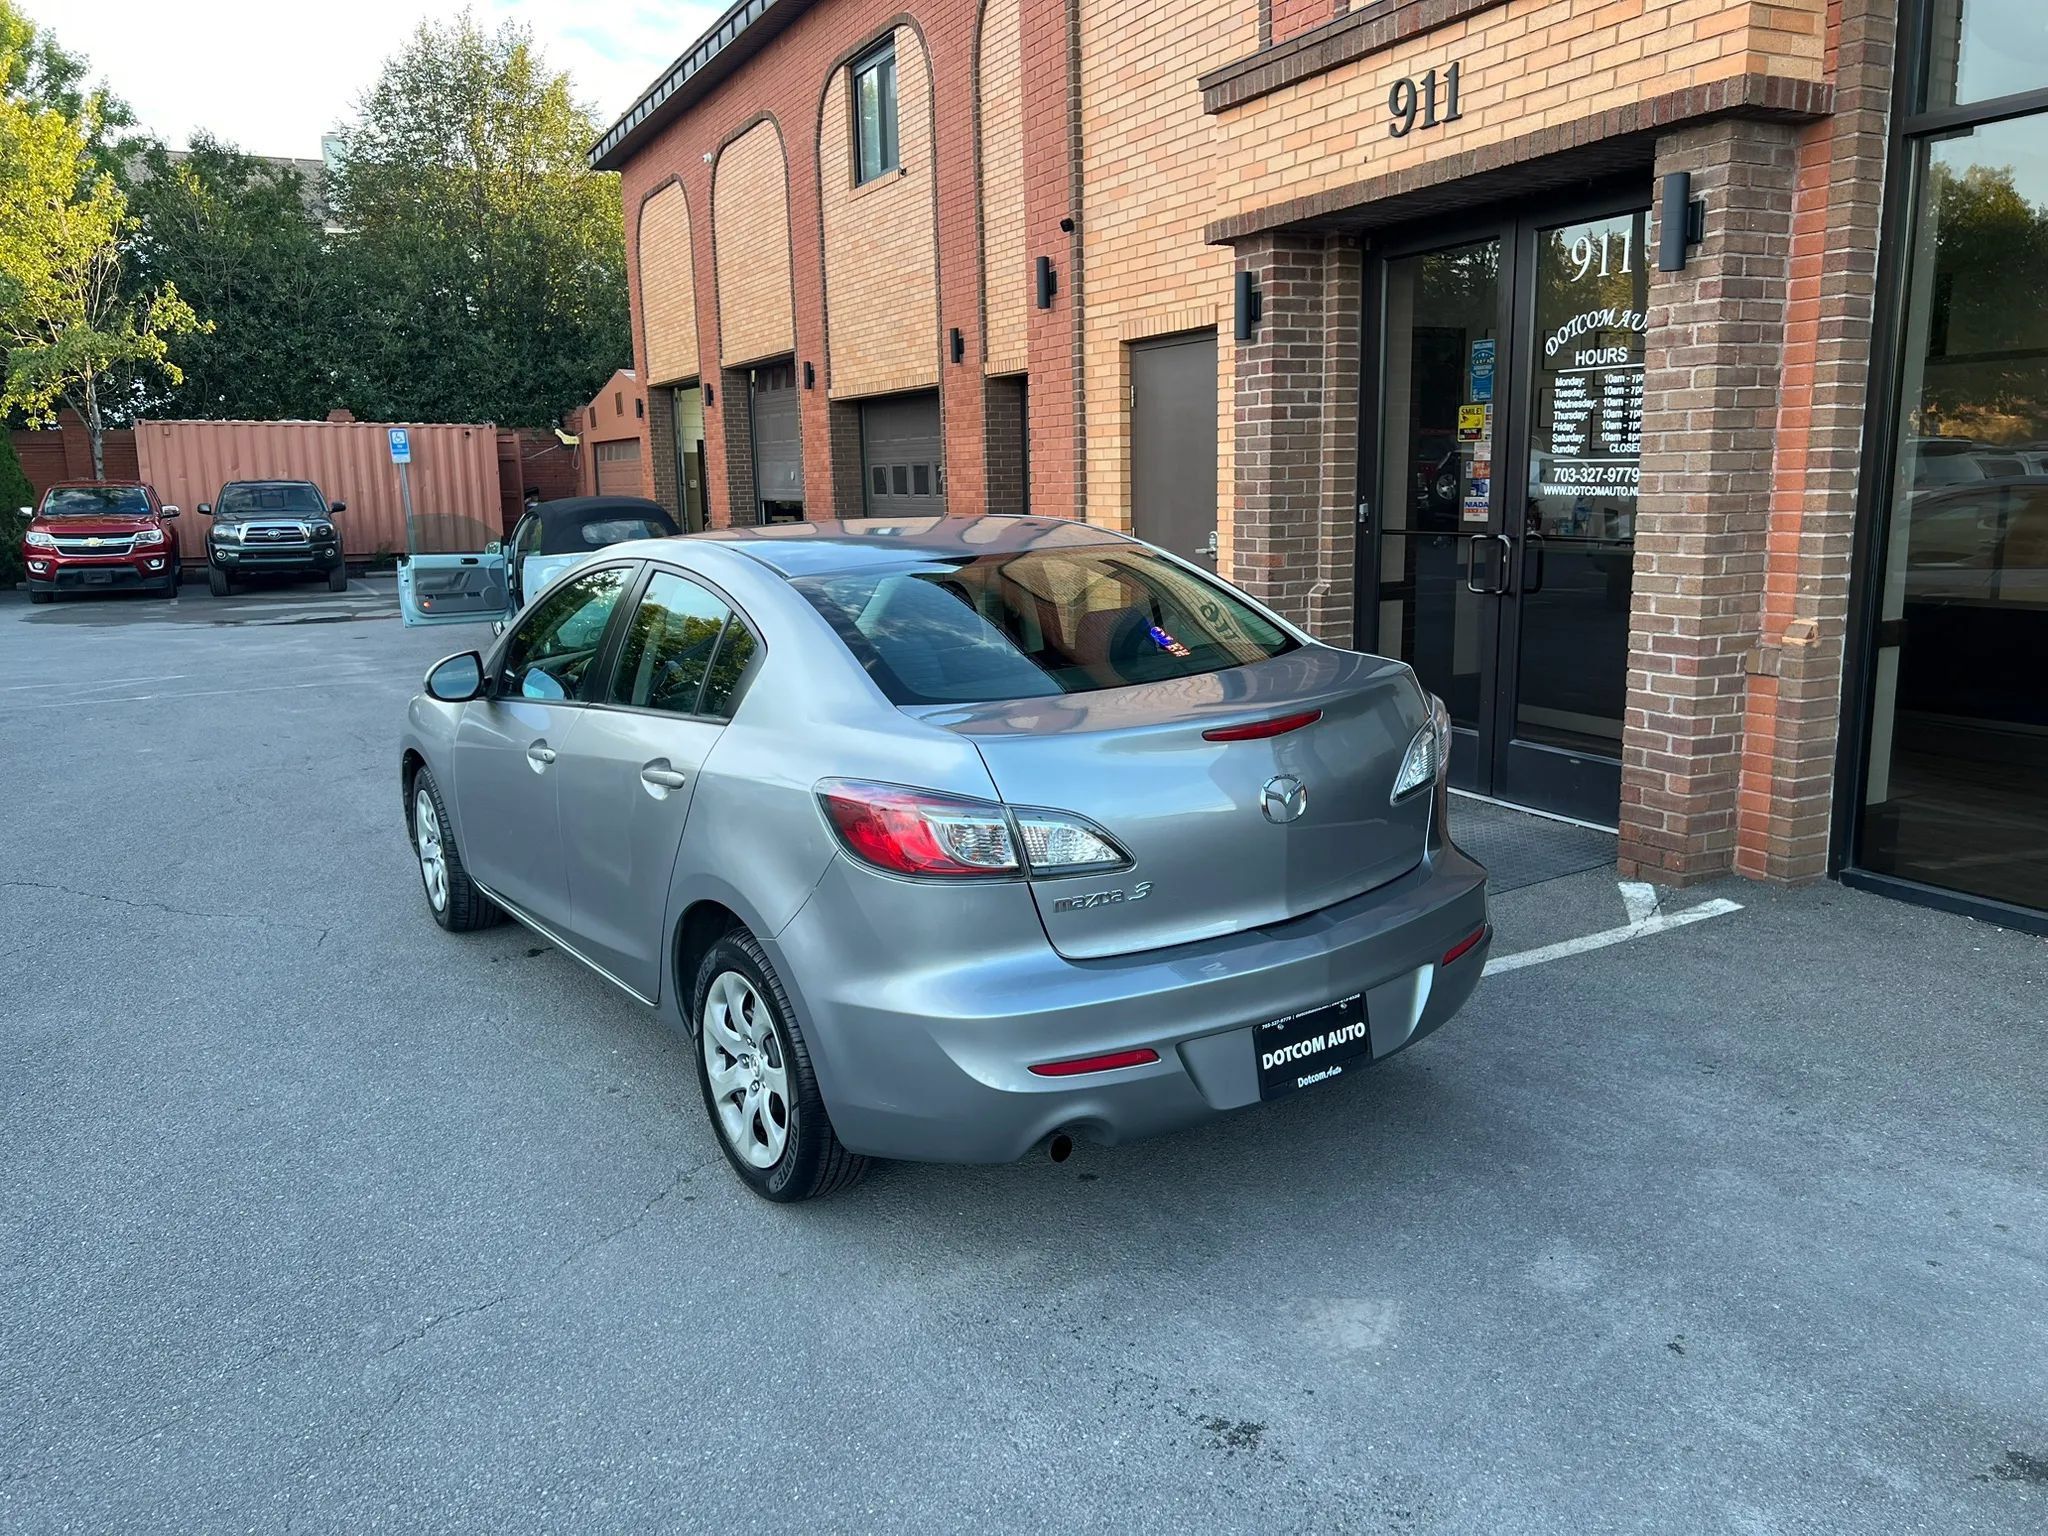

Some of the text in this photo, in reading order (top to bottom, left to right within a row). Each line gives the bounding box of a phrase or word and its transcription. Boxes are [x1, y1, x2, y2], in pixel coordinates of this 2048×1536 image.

[1389, 62, 1463, 138] 911
[1570, 228, 1632, 282] 911
[1545, 307, 1648, 356] DOTCOM AU
[1575, 346, 1628, 366] HOURS
[1555, 377, 1585, 387] Monday:
[1604, 374, 1625, 383] 10am
[1554, 388, 1586, 398] Tuesday:
[1603, 386, 1624, 395] 10am
[1553, 399, 1597, 409] Wednesday:
[1603, 398, 1624, 407] 10am
[1553, 411, 1588, 421] Thursday:
[1602, 409, 1623, 418] 10am
[1552, 422, 1576, 433] Friday:
[1601, 421, 1622, 430] 10am
[1552, 433, 1585, 443] Saturday:
[1601, 432, 1621, 441] 10am
[1551, 444, 1580, 455] Sunday:
[1553, 467, 1640, 483] 703-327-9779
[1128, 881, 1153, 901] 3
[1262, 1022, 1366, 1070] DOTCOM AUTO
